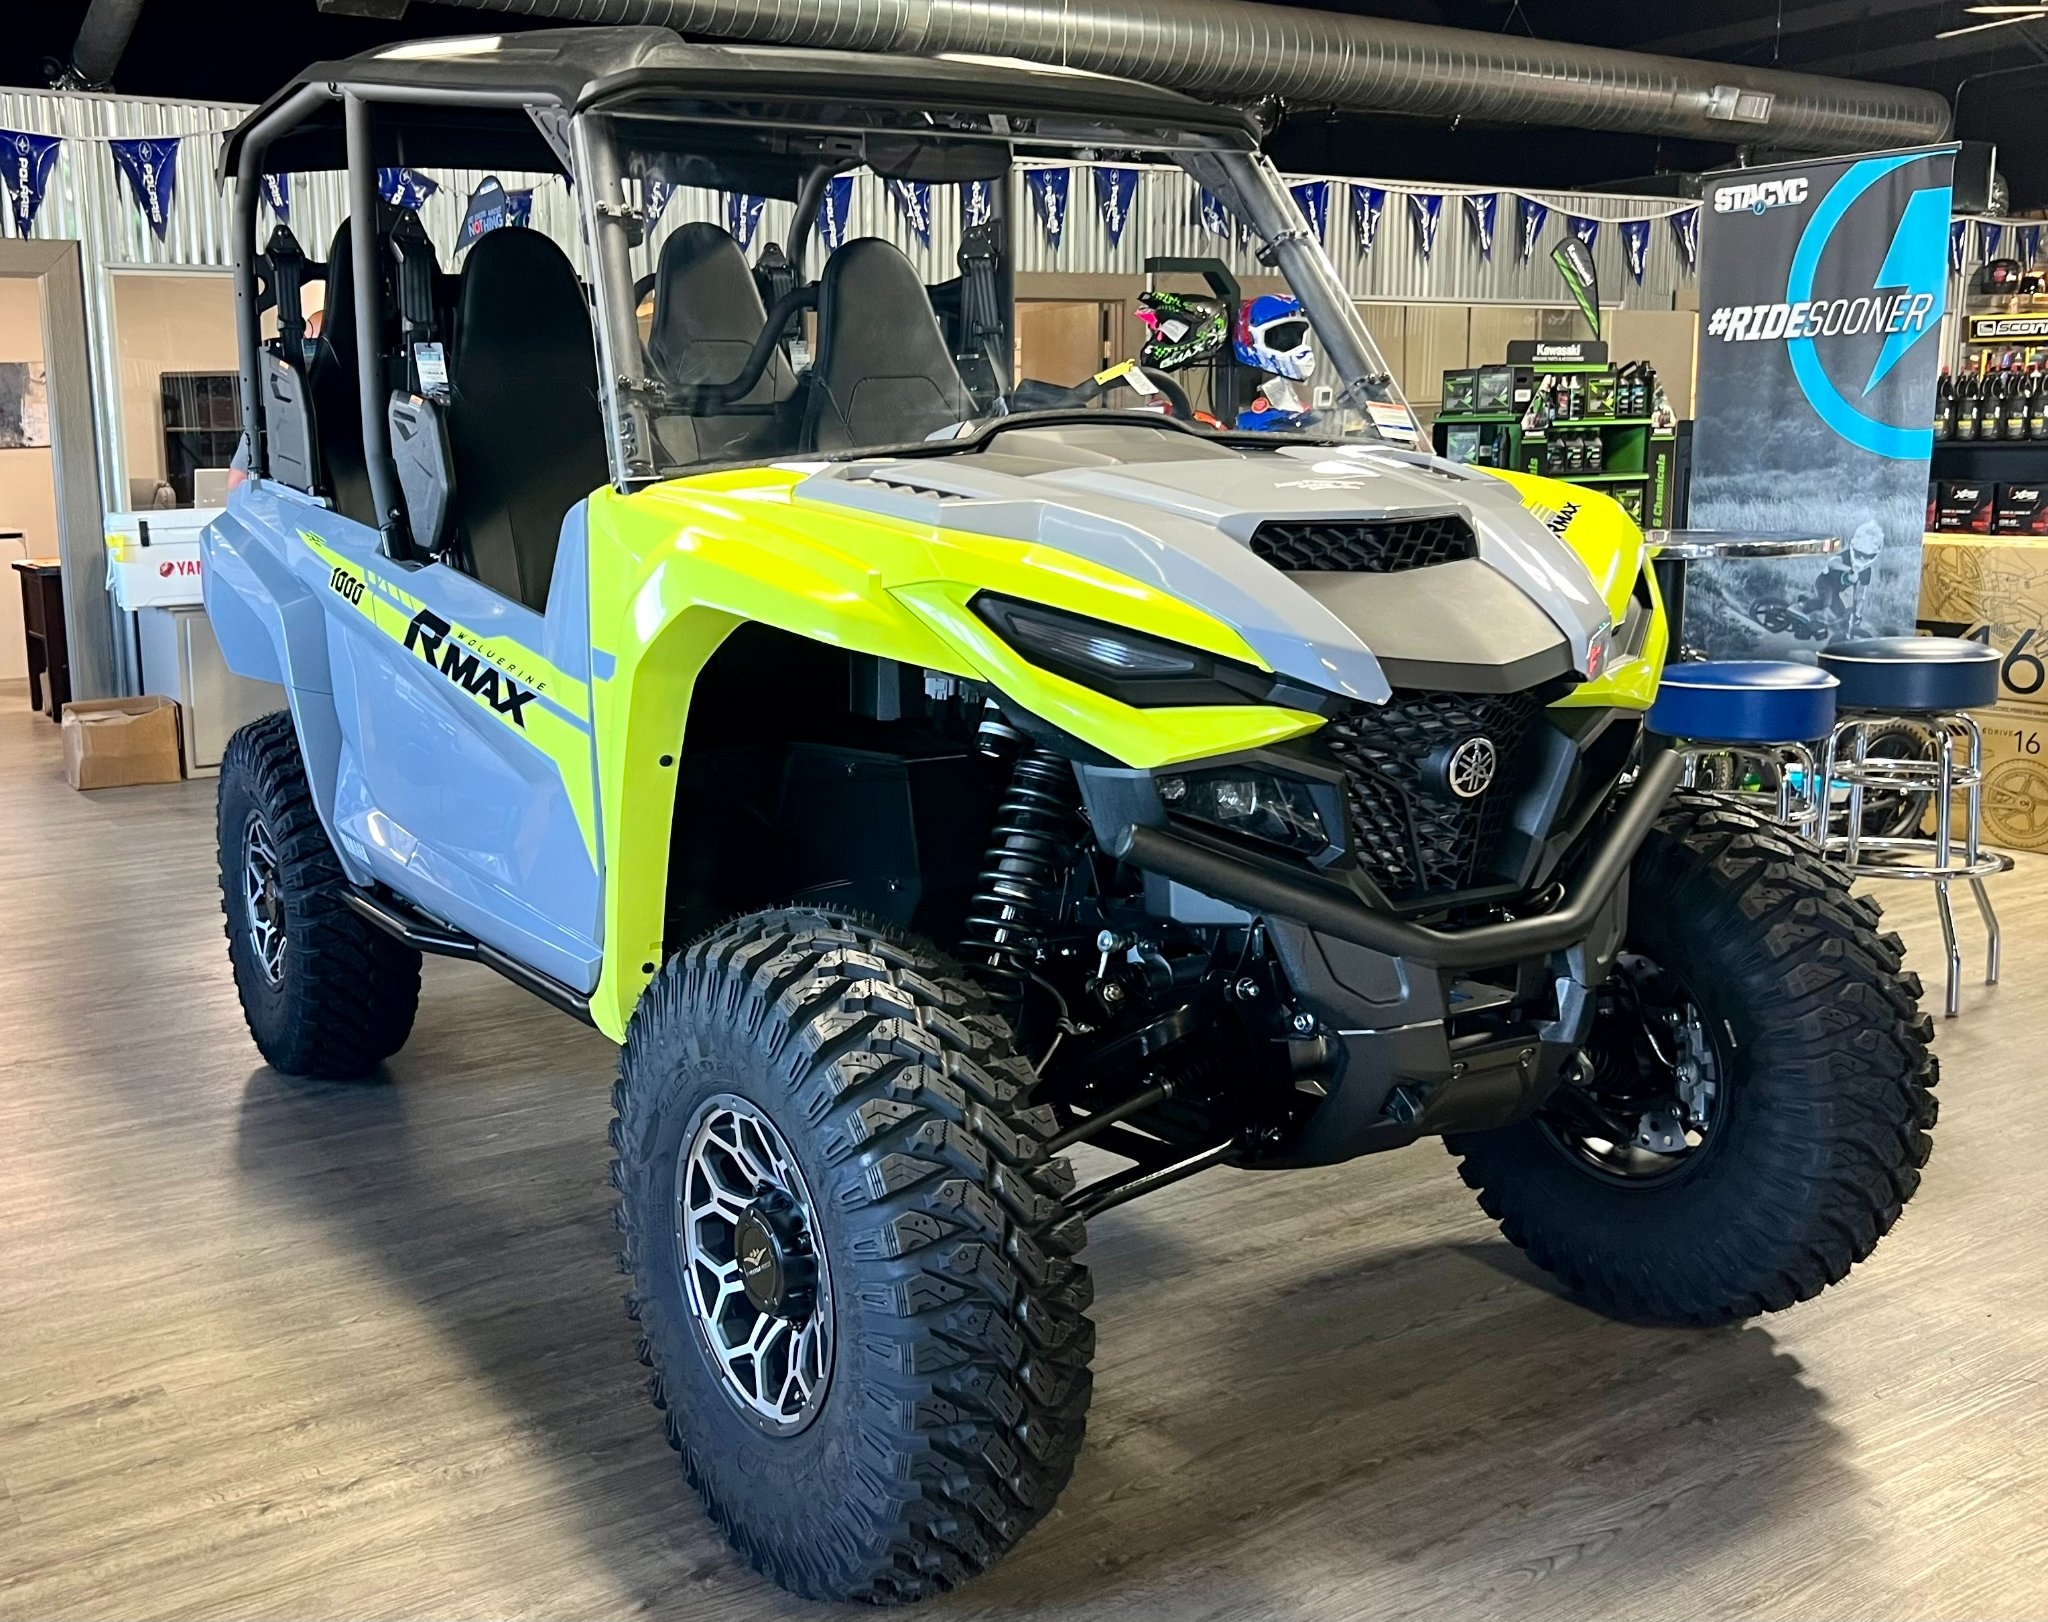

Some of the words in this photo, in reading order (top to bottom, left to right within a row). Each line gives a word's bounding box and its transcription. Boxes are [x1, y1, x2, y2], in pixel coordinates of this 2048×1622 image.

[18, 157, 30, 218] POLARIS
[142, 163, 163, 224] POLARIS
[1714, 177, 1809, 213] STACYC
[467, 213, 504, 238] NOTHING
[825, 197, 838, 248] POLARIS
[1707, 293, 1934, 342] #RIDESOONER
[1536, 343, 1581, 356] Kawasaki
[1652, 454, 1666, 516] Chemicals
[330, 567, 366, 606] 1000
[403, 608, 538, 729] RMAX
[2014, 730, 2041, 755] 16
